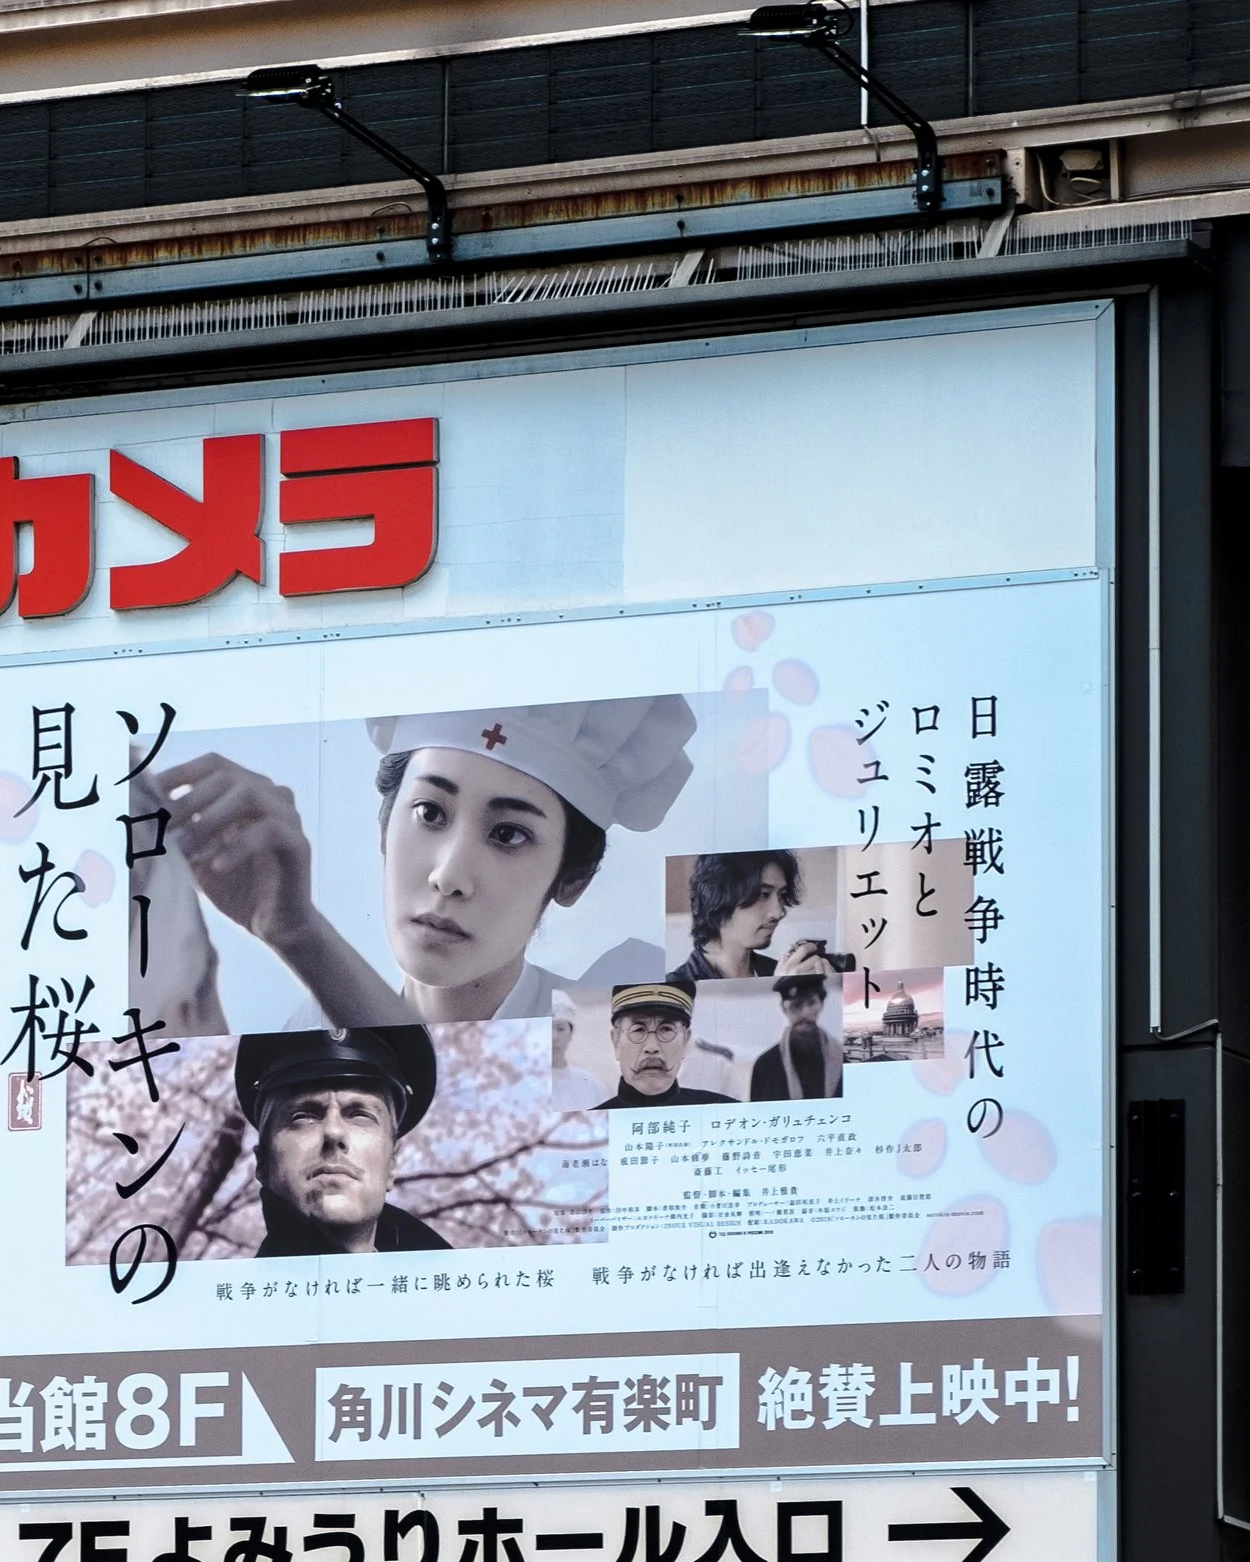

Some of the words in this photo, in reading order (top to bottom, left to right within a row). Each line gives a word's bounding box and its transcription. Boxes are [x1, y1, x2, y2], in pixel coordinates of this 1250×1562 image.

[0, 702, 100, 1083] 見た桜
[850, 698, 890, 1010] ジュリエット
[910, 703, 942, 917] ロミオと
[962, 694, 1006, 1139] 日露戦争時代の
[108, 701, 186, 1305] ソローキンの
[631, 1119, 692, 1136] 阿部純子
[215, 1267, 555, 1301] 戦争がなければ一緒に眺められた桜
[591, 1249, 1011, 1286] 戦争がなければ出逢えなかった二人の物語
[327, 1373, 724, 1443] 角川シネマ有楽町
[756, 1355, 1081, 1432] 絶賛上映中!
